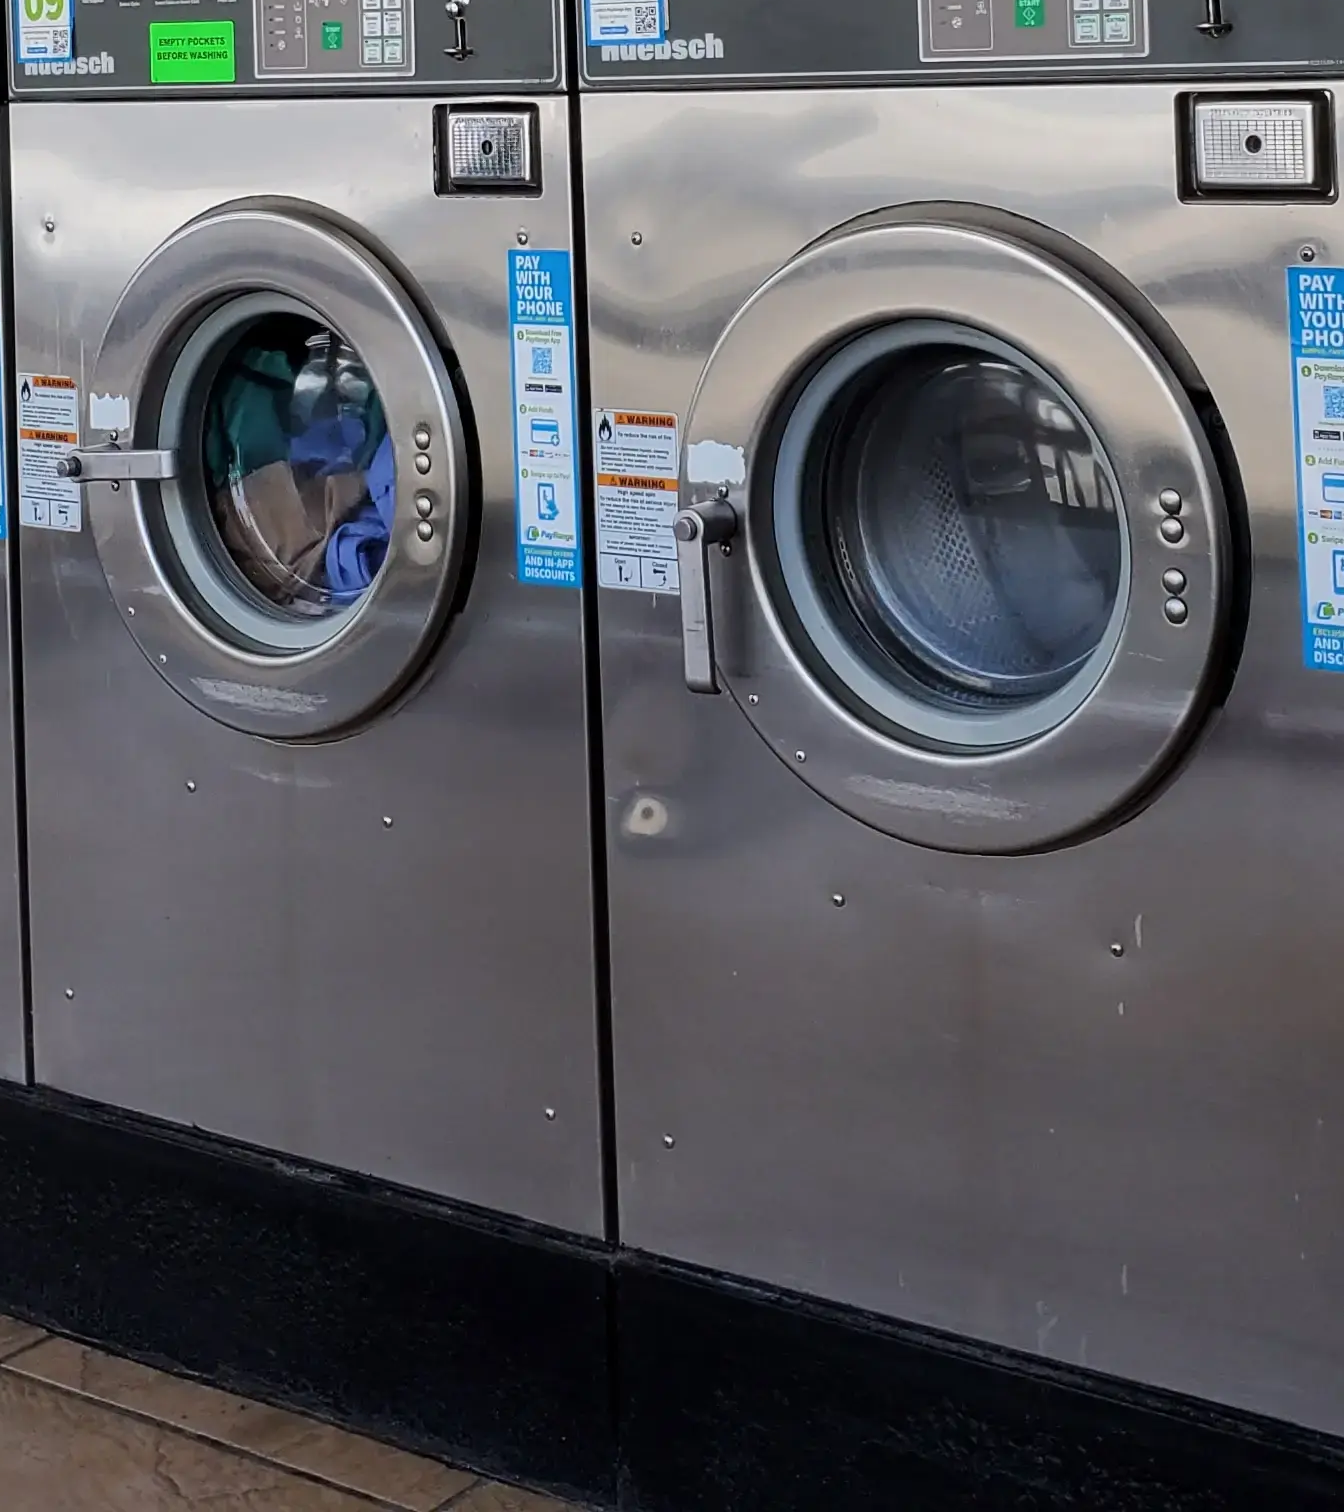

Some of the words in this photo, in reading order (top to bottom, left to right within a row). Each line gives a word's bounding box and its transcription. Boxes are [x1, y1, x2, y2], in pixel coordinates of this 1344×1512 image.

[1019, 0, 1040, 7] START
[159, 37, 185, 46] EMPTY
[187, 36, 225, 46] POCKETS
[157, 51, 188, 61] BEFORE
[189, 50, 228, 60] WASHING
[516, 255, 540, 270] PAY
[516, 270, 550, 285] WITH
[1299, 274, 1335, 291] PAY
[516, 285, 553, 300] YOUR
[517, 301, 563, 316] PHONE
[627, 415, 673, 427] WARNING
[1318, 457, 1333, 466] Add
[618, 477, 666, 489] WARNING
[1321, 535, 1344, 546] Swipe
[525, 555, 543, 566] AND
[545, 557, 574, 568] IN-APP
[525, 567, 575, 582] DISCOUNTS
[1314, 638, 1341, 650] AND
